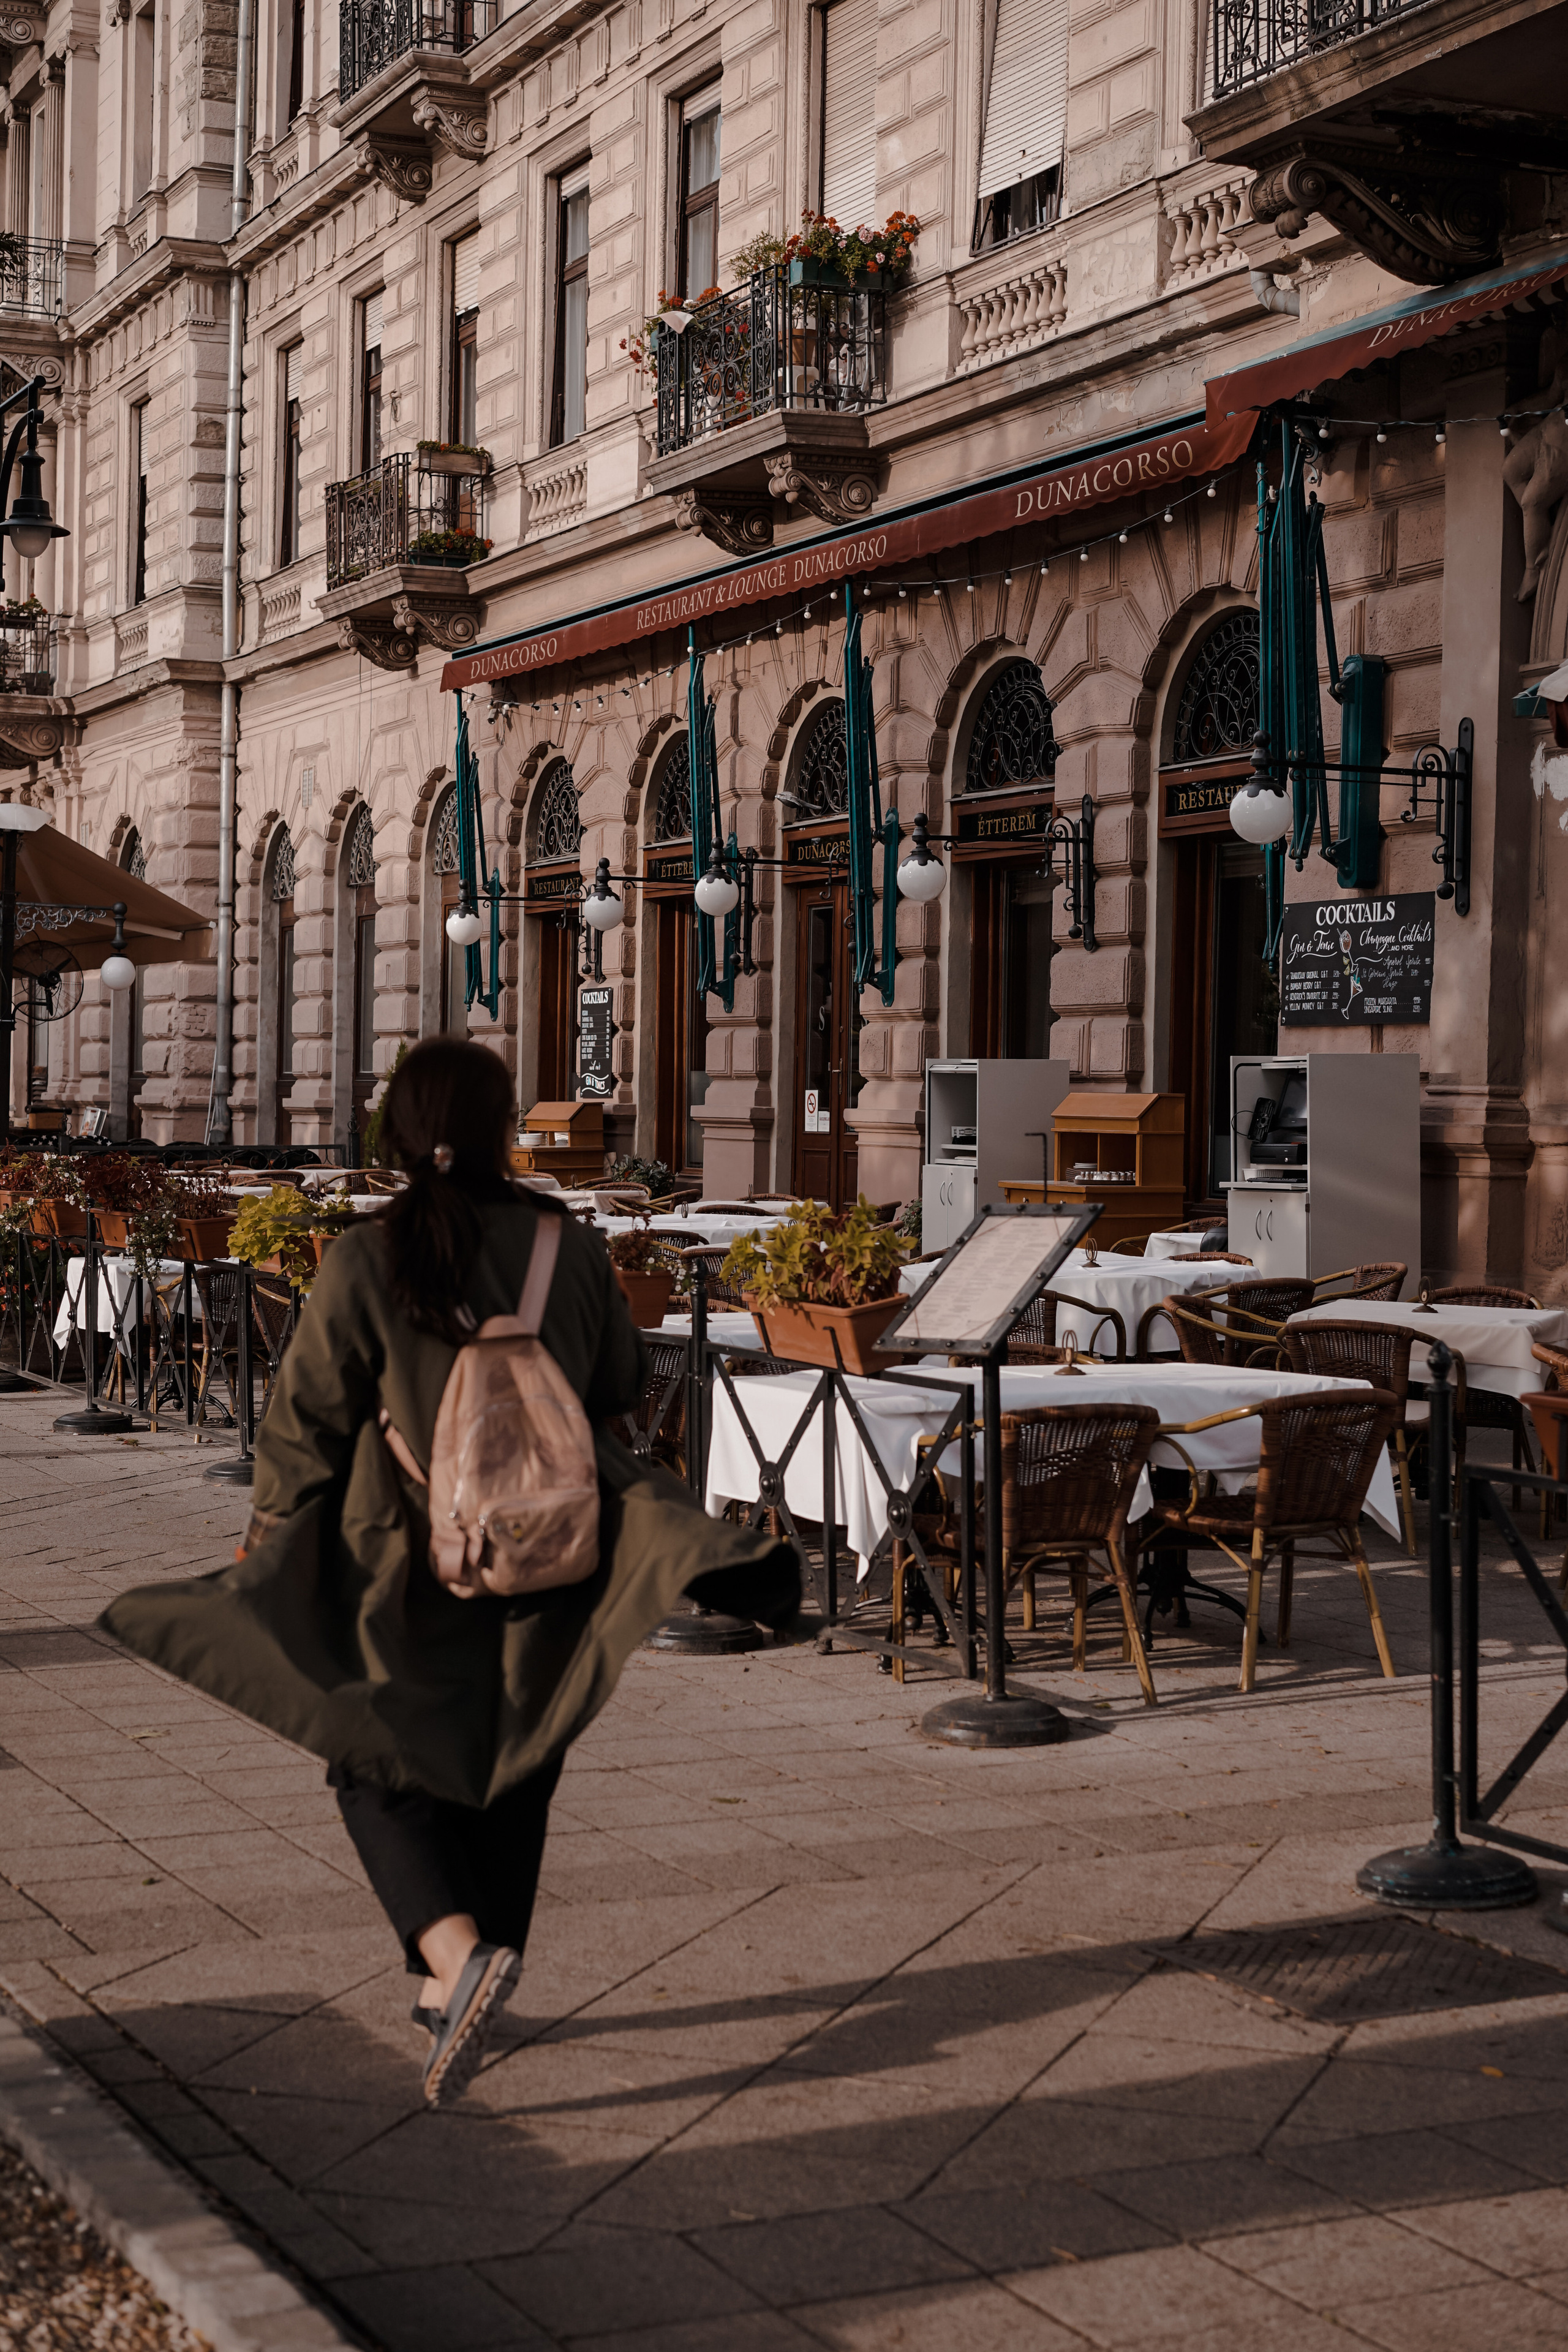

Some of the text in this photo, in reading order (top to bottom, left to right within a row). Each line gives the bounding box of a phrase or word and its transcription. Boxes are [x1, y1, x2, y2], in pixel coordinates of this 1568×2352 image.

[1367, 268, 1558, 349] DUNACORSO
[1016, 439, 1195, 519] DUNACORSO
[636, 535, 888, 631] RESTAURANT & LOUNGE DUNACORSO
[470, 637, 558, 679] DUNACORSO
[1178, 785, 1244, 810] RESTAU
[978, 812, 1036, 837] ÉTTEREM
[797, 839, 851, 861] DUNACORS
[661, 861, 694, 878] ÉTTERE
[534, 876, 581, 895] RESTAURANT
[1316, 900, 1396, 926] COCKTAILS
[1286, 933, 1306, 964] Gin
[1313, 929, 1335, 951] Tonic
[1360, 919, 1432, 954] Champagne Cocktails
[1383, 955, 1404, 970] Aperol
[1406, 955, 1422, 968] Spritz
[582, 991, 609, 1005] COCKTAILS
[1363, 1005, 1382, 1014] SINGAPORE
[1364, 997, 1376, 1006] FROZEN
[1378, 997, 1397, 1005] MARGARITA
